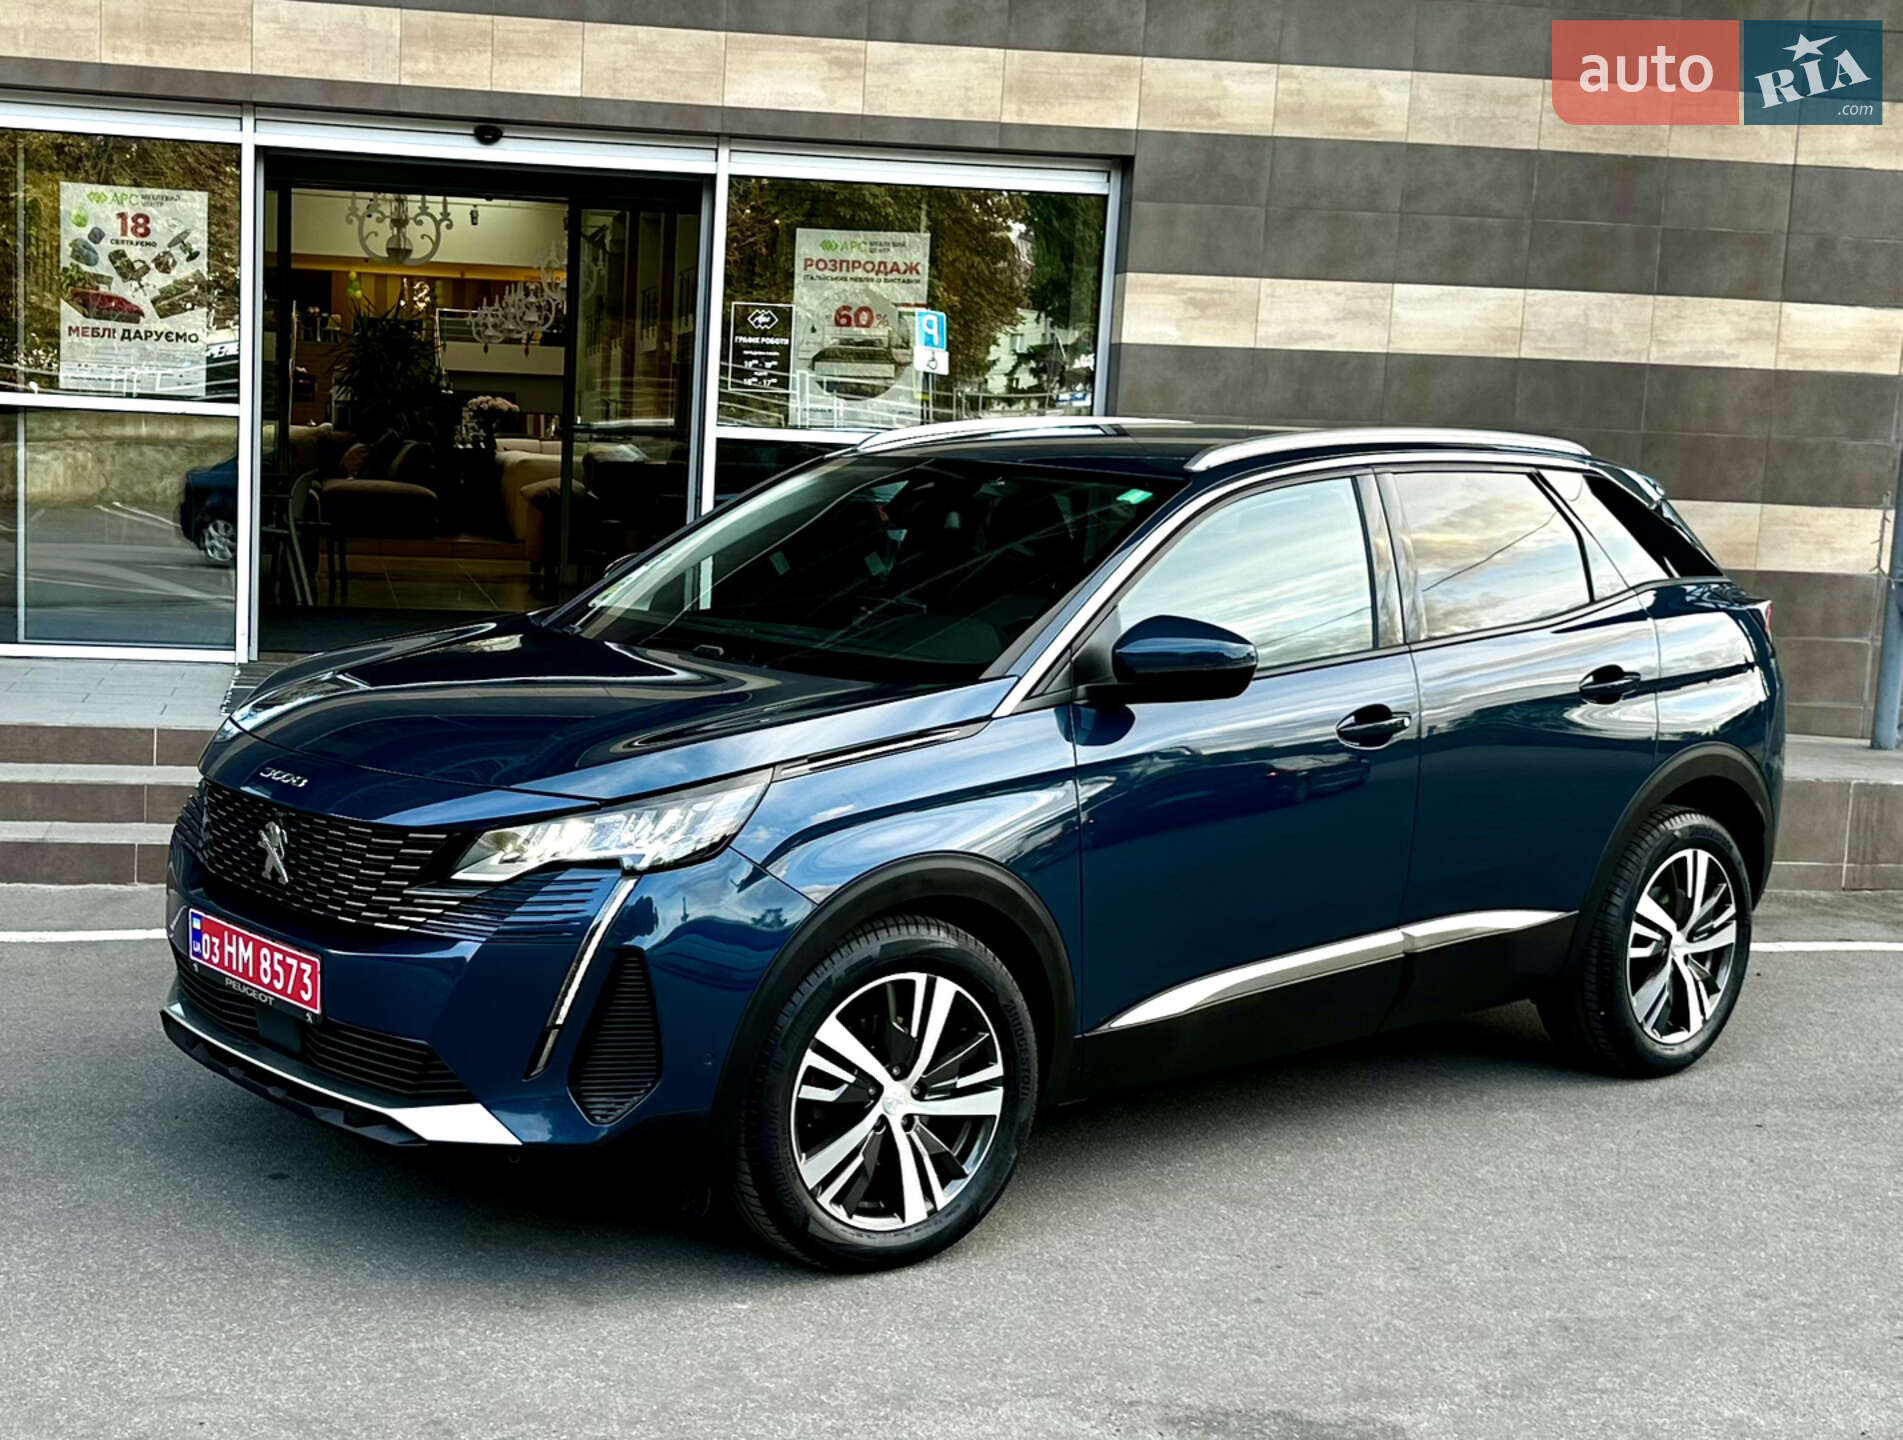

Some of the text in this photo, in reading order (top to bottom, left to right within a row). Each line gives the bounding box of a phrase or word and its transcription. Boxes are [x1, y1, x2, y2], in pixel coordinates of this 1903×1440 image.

[116, 212, 151, 238] 18
[803, 258, 920, 276] РОЗПРОДАЖ
[120, 328, 199, 344] ДАРУЄМО
[202, 933, 220, 964] 03
[224, 930, 253, 978] HM
[260, 947, 312, 1001] 8573
[225, 977, 275, 1006] PEUGEOT
